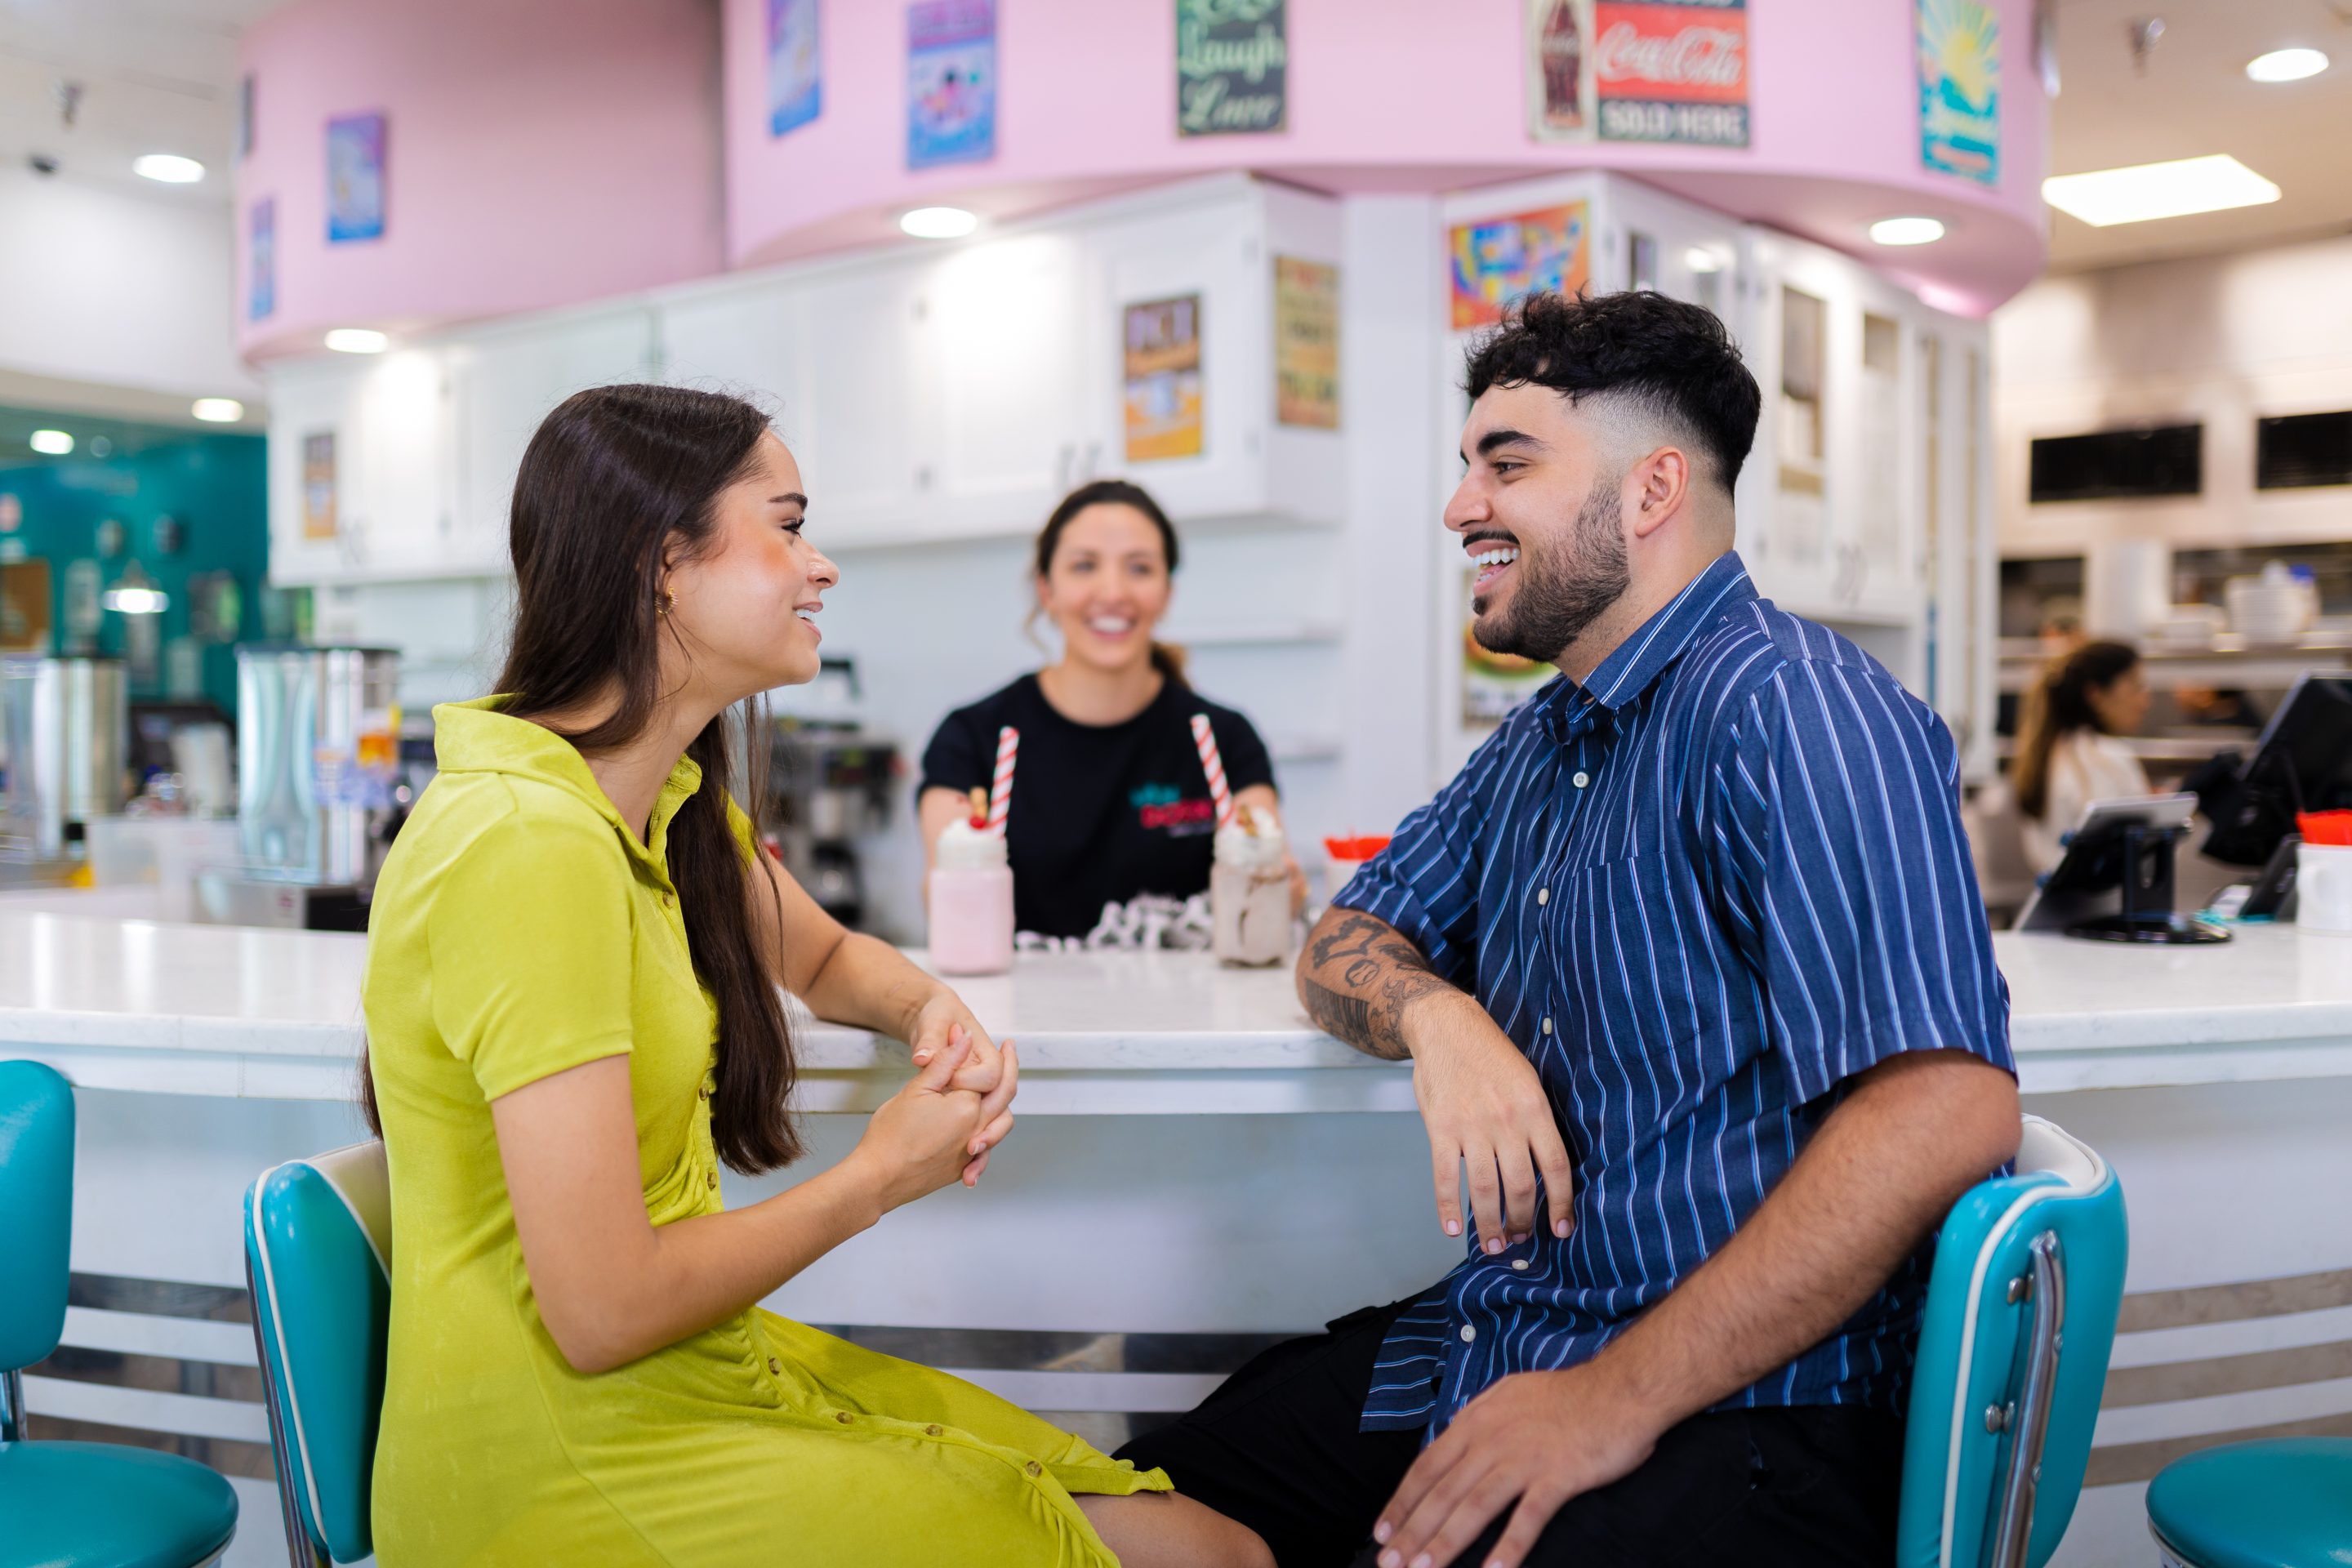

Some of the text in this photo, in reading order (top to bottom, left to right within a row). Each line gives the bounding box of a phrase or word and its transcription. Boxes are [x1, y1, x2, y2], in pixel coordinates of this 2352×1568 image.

[1178, 20, 1286, 82] Laugh
[1600, 100, 1745, 143] SOLD HERE
